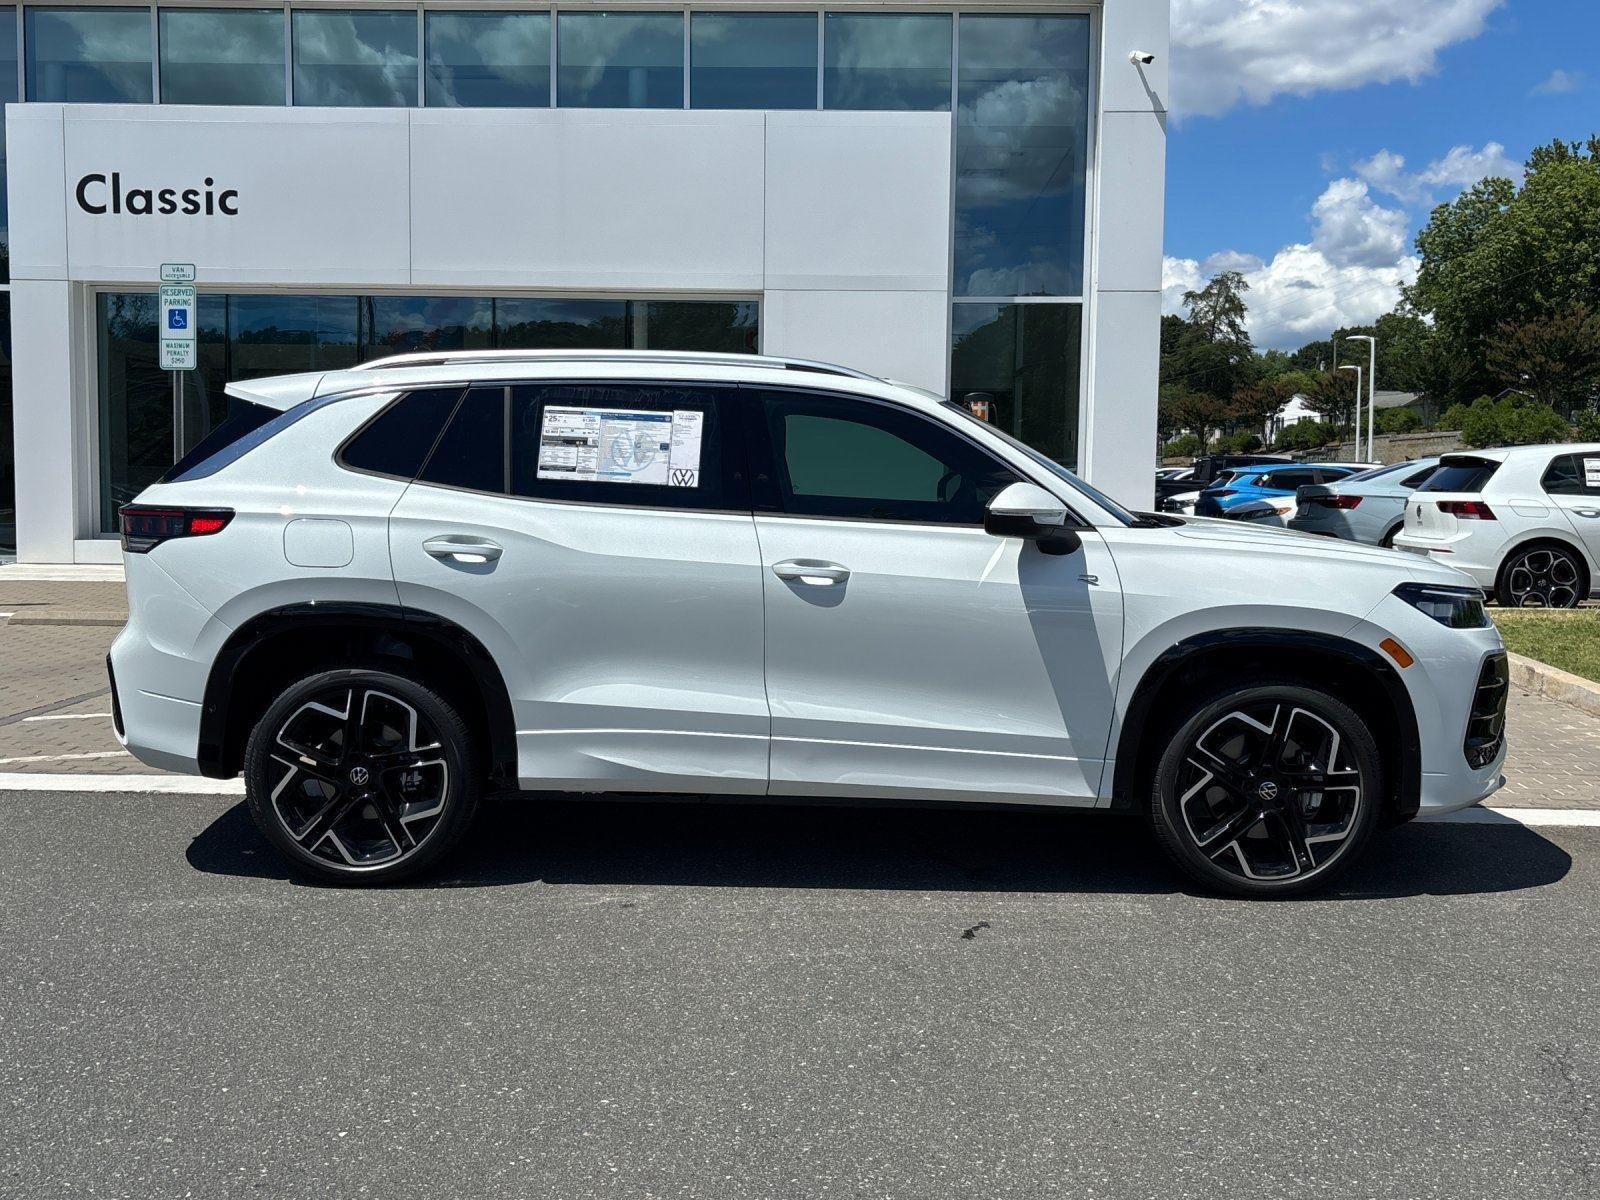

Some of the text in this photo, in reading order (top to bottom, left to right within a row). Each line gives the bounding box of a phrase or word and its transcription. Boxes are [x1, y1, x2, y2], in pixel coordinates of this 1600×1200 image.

[76, 172, 239, 216] Classic
[161, 288, 194, 297] RESERVED
[164, 298, 192, 307] PARKING
